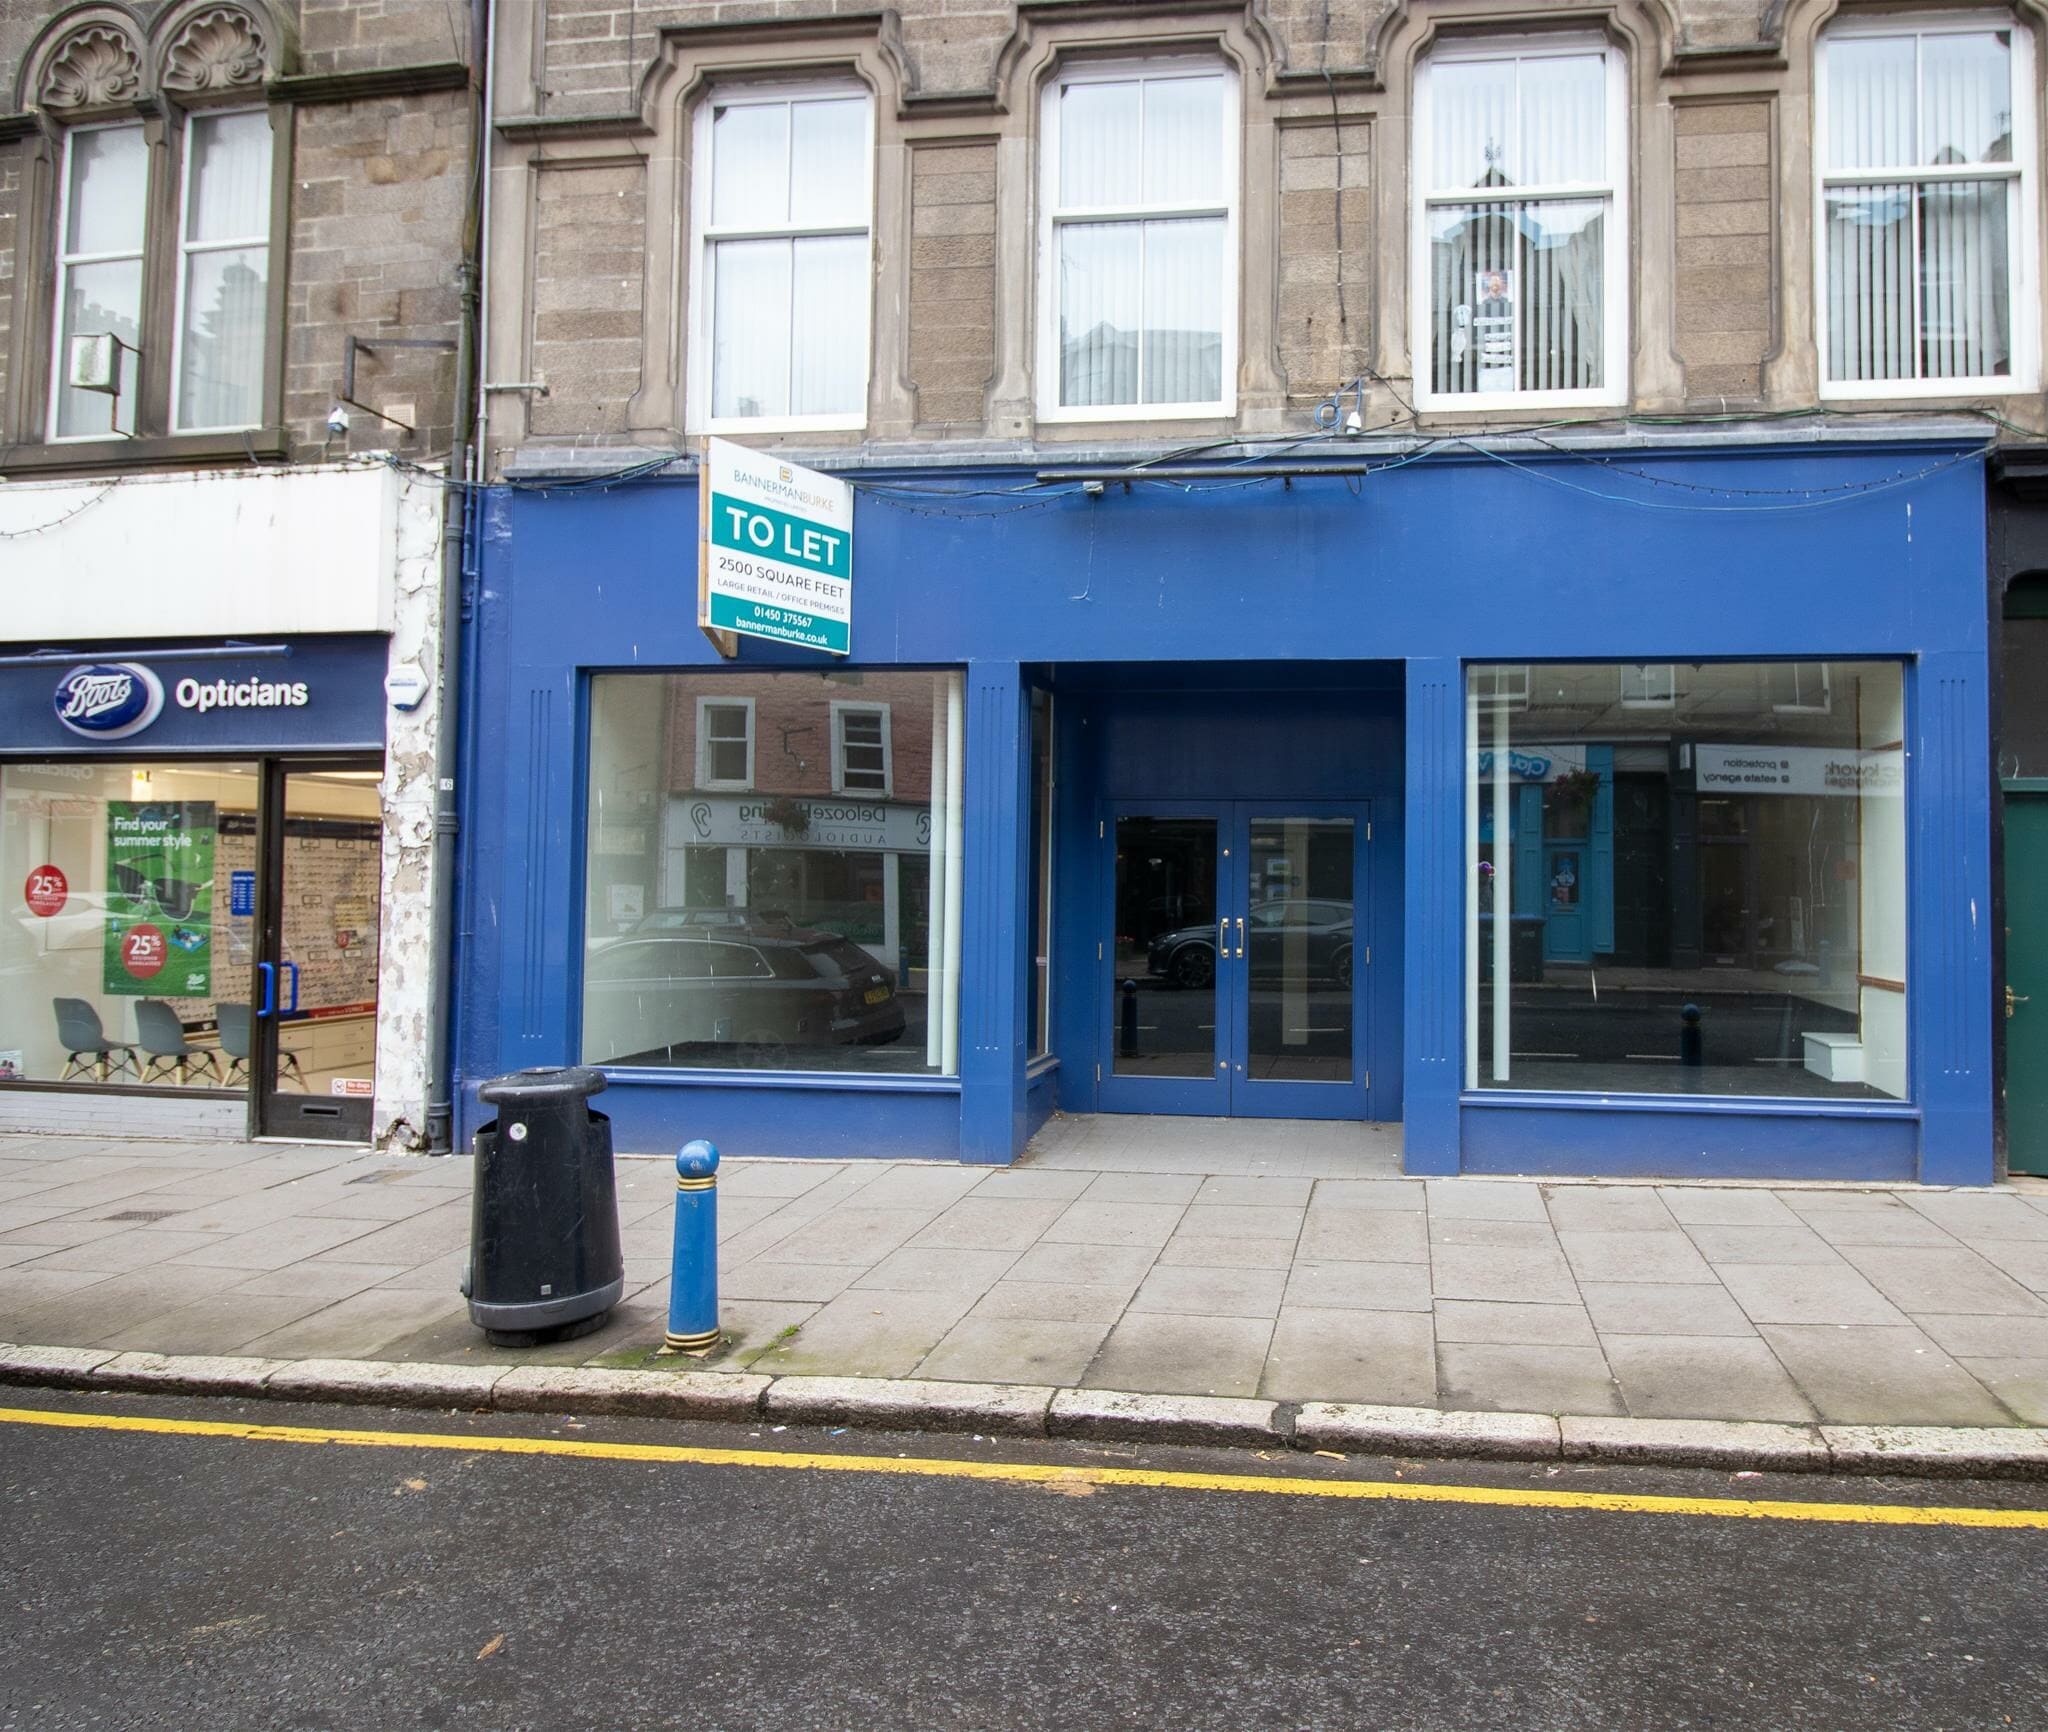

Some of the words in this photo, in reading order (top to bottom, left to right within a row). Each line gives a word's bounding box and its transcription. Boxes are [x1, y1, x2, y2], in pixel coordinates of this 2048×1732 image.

[734, 469, 835, 512] BANNERMANBURKE
[726, 507, 775, 547] TO
[784, 524, 840, 566] LET
[719, 557, 752, 576] 2500
[757, 566, 811, 591] SQUARE
[815, 581, 844, 599] FEET
[718, 578, 746, 592] LARGE
[748, 584, 774, 600] RETAIL
[781, 593, 808, 607] OFFICE
[810, 599, 845, 615] PREMISES
[735, 616, 828, 645] bannermanburke.co.uk
[754, 606, 780, 622] 01450
[783, 612, 812, 628] 375567
[61, 673, 133, 718] Boots
[176, 677, 309, 712] Opticians
[114, 816, 140, 831] Find
[140, 820, 168, 834] your
[114, 836, 161, 847] summer
[162, 832, 192, 851] style
[32, 875, 63, 895] 25%
[129, 934, 161, 955] 25%
